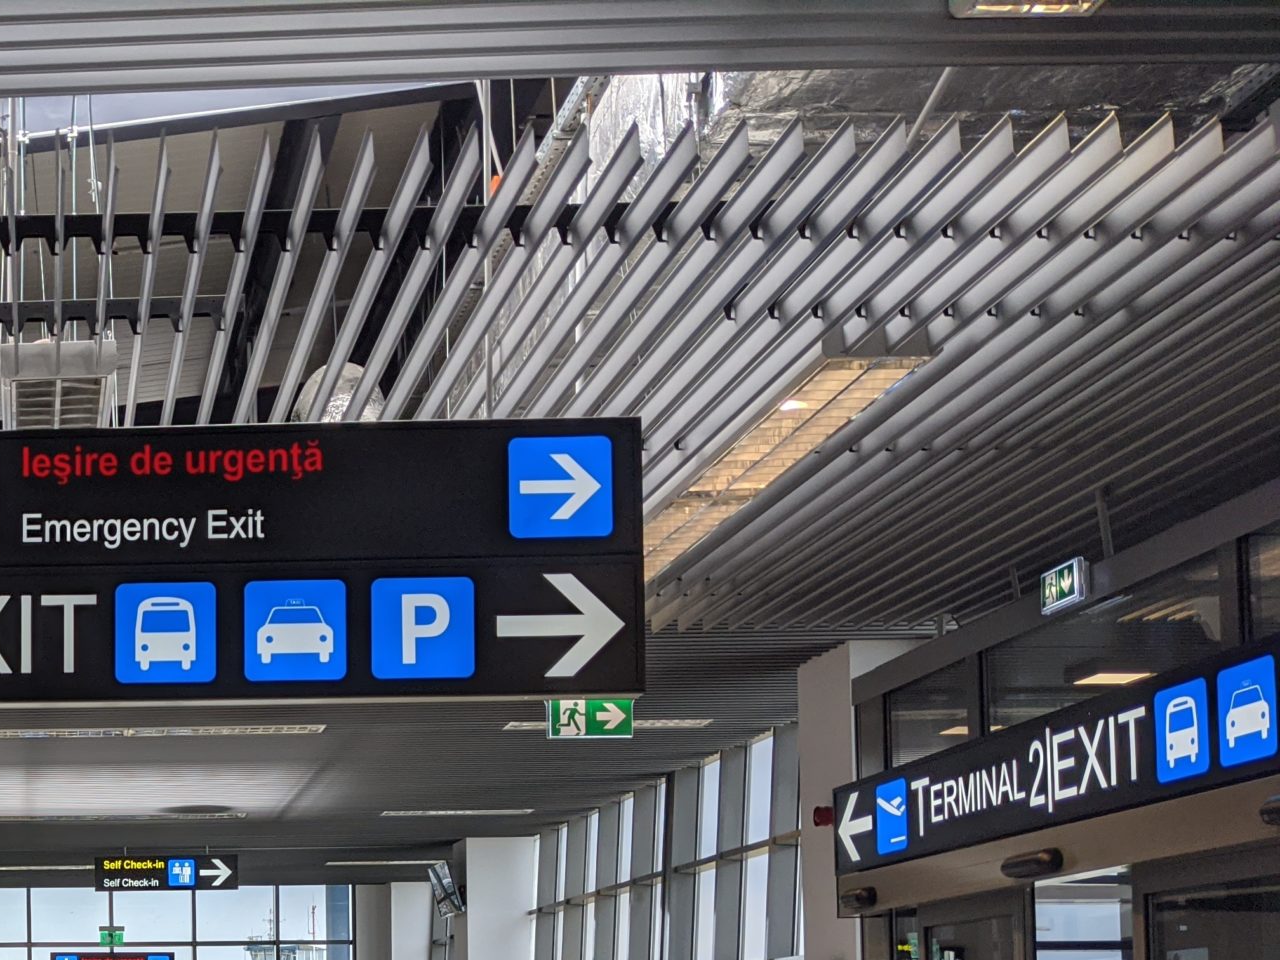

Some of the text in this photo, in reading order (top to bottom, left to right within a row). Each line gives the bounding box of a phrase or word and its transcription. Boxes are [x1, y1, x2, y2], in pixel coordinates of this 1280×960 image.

[130, 444, 173, 475] de
[22, 509, 265, 549] Emergency Exit
[401, 593, 451, 664] P
[1052, 706, 1146, 800] EXIT
[103, 859, 165, 870] Self Check-in
[103, 878, 159, 887] Self Check-in
